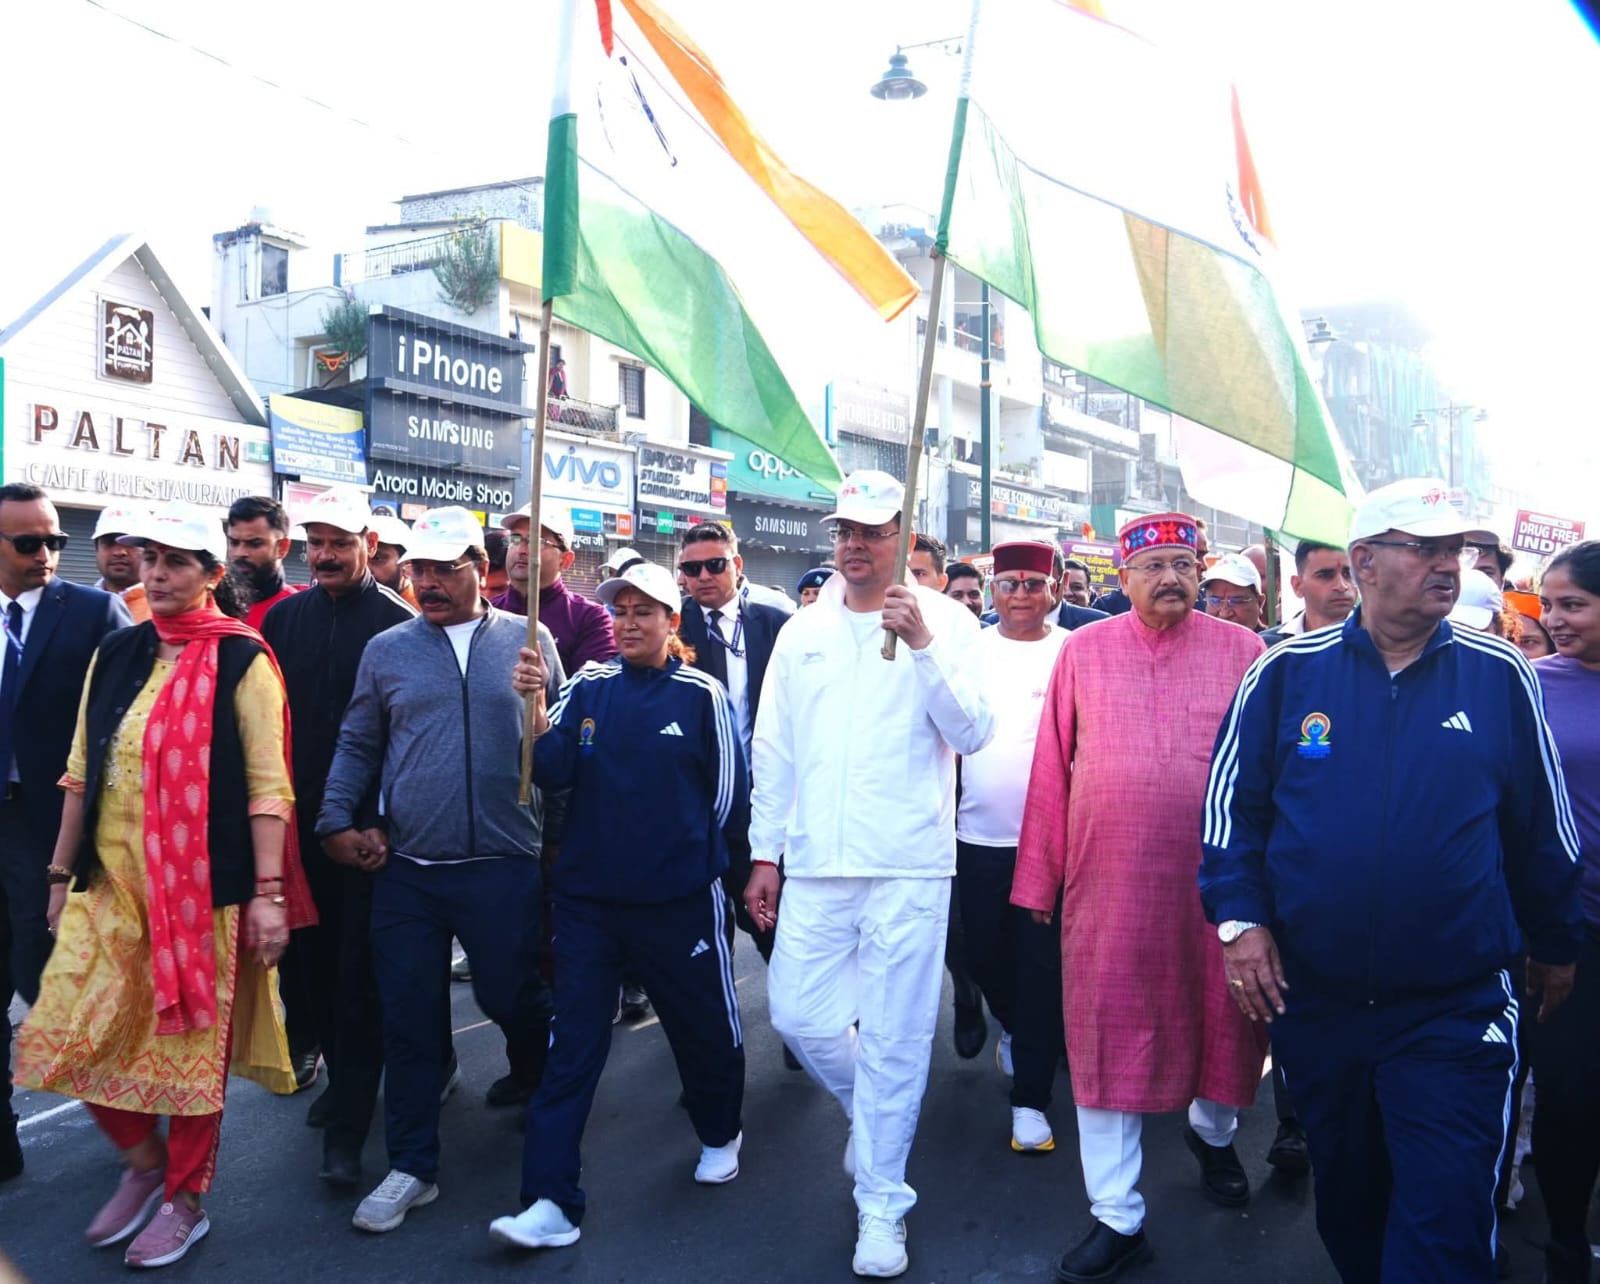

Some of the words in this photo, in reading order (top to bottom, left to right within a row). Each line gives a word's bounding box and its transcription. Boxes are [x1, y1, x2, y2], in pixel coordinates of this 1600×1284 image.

[32, 403, 240, 470] PALTAN
[408, 415, 494, 450] SAMSUNG
[26, 462, 90, 490] CAFE
[544, 445, 621, 489] vivo
[373, 469, 417, 495] Arora
[422, 476, 472, 501] Mobile
[477, 483, 512, 510] Shop
[640, 483, 709, 504] COMMUNICATION
[755, 516, 808, 537] SAMSUNG
[1519, 521, 1550, 538] DRUG
[1551, 528, 1580, 543] FREE
